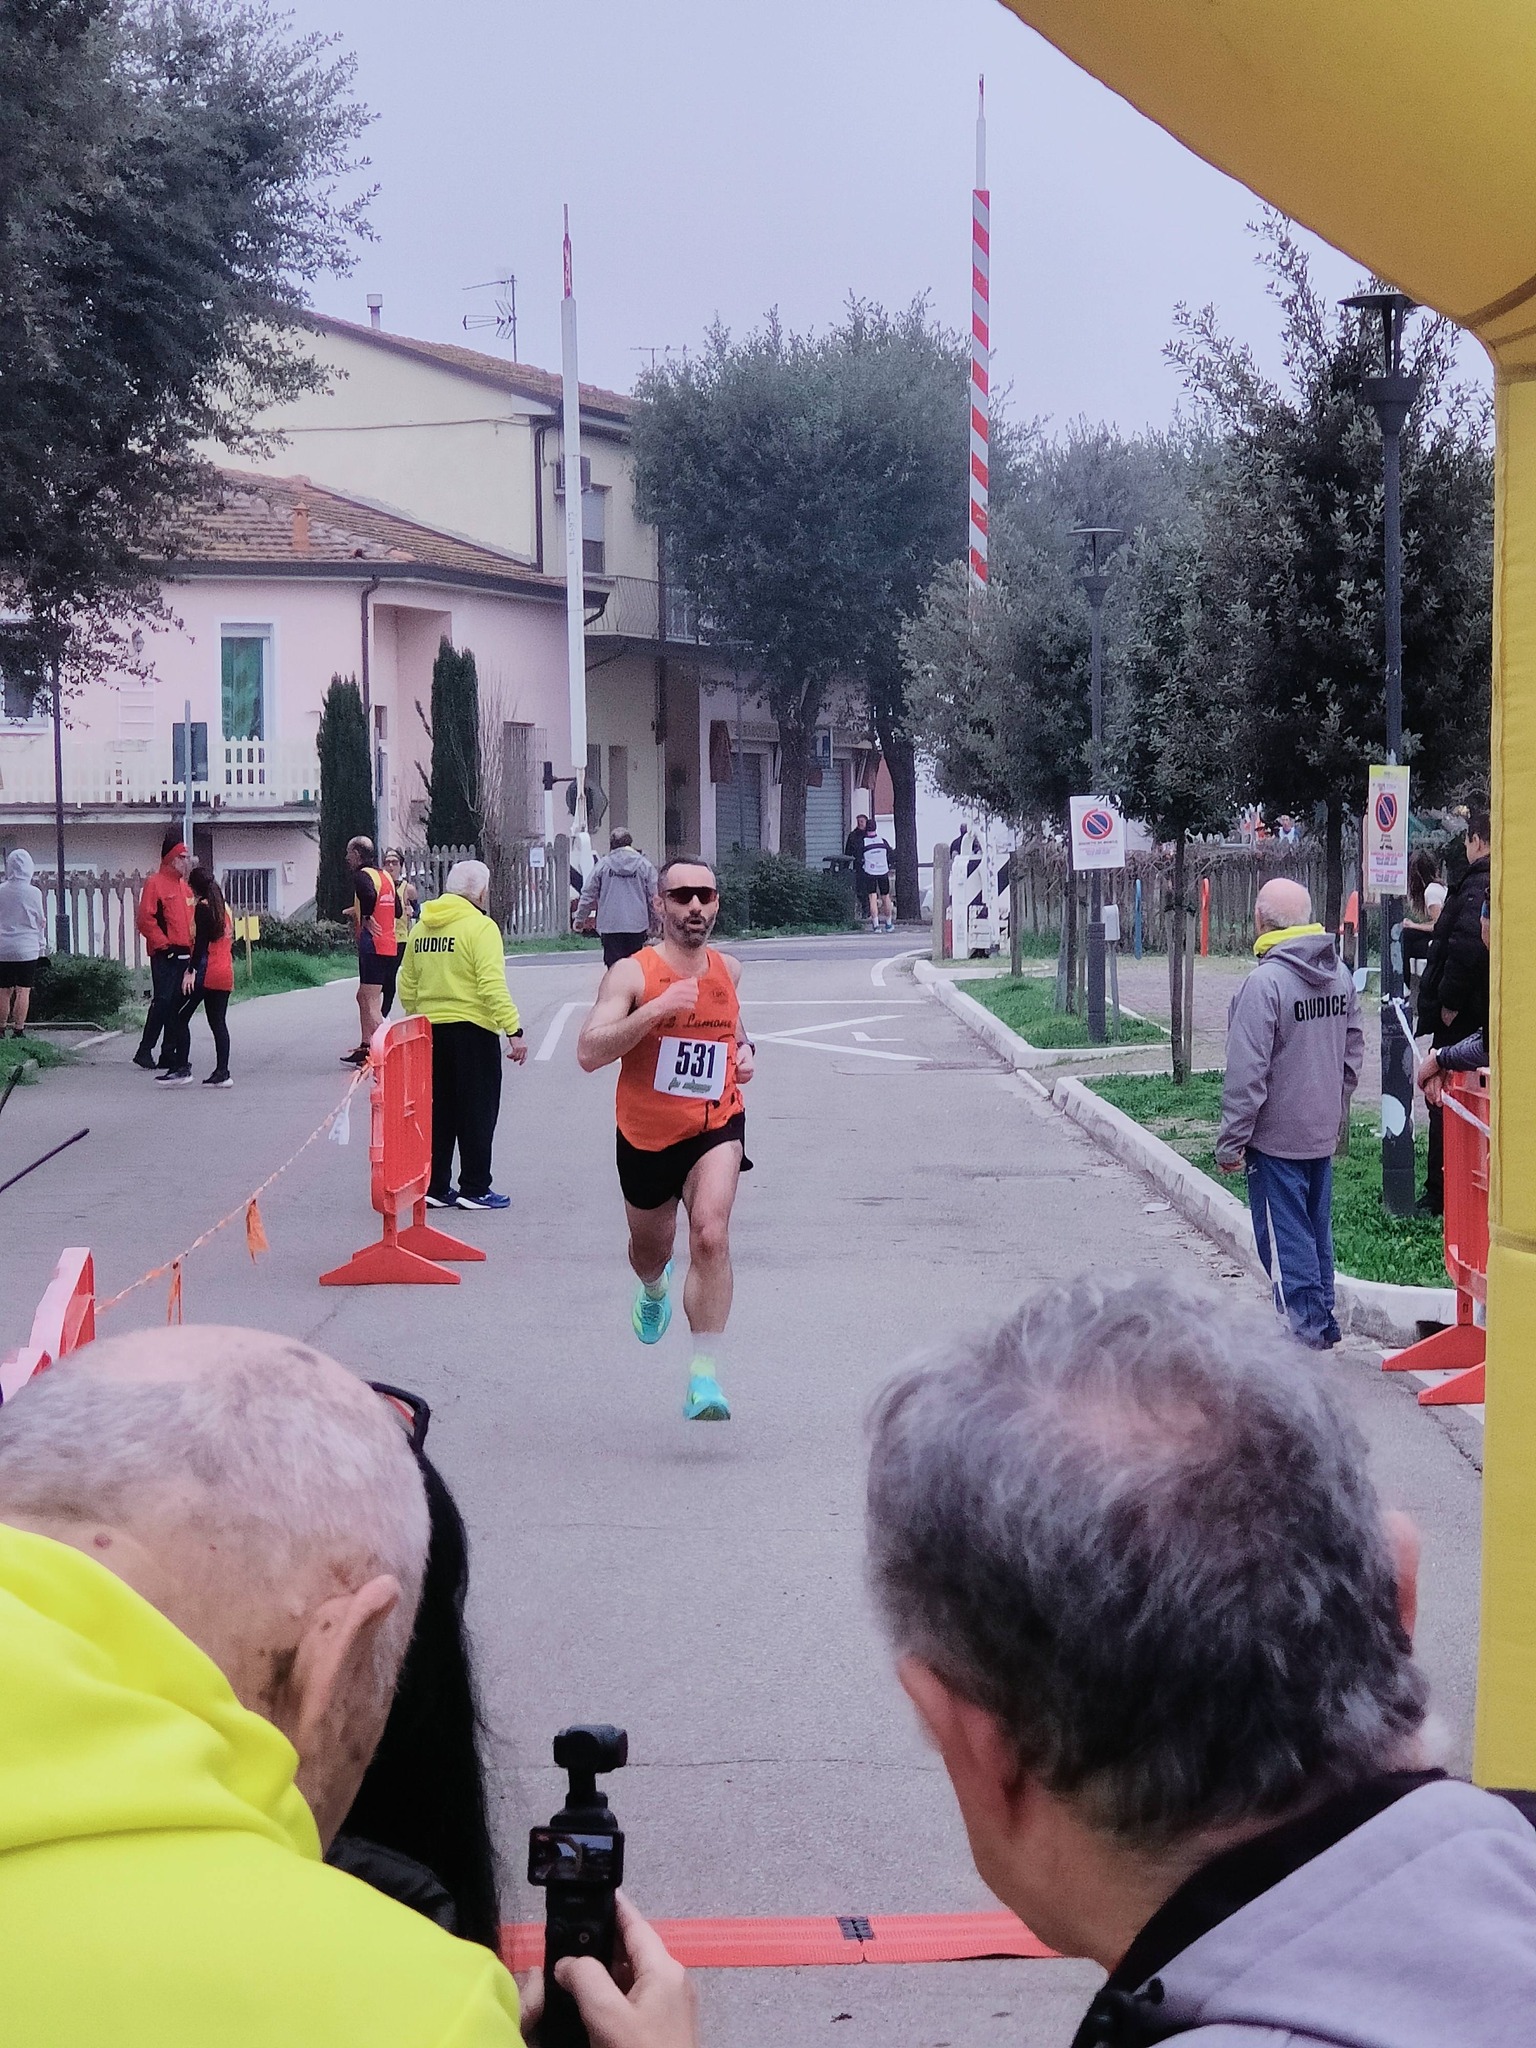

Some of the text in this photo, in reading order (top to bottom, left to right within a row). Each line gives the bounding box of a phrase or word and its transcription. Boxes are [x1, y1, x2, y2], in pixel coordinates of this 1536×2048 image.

[414, 936, 455, 953] GIUDICE
[1293, 994, 1347, 1022] GIUDICE
[674, 1041, 716, 1079] 531
